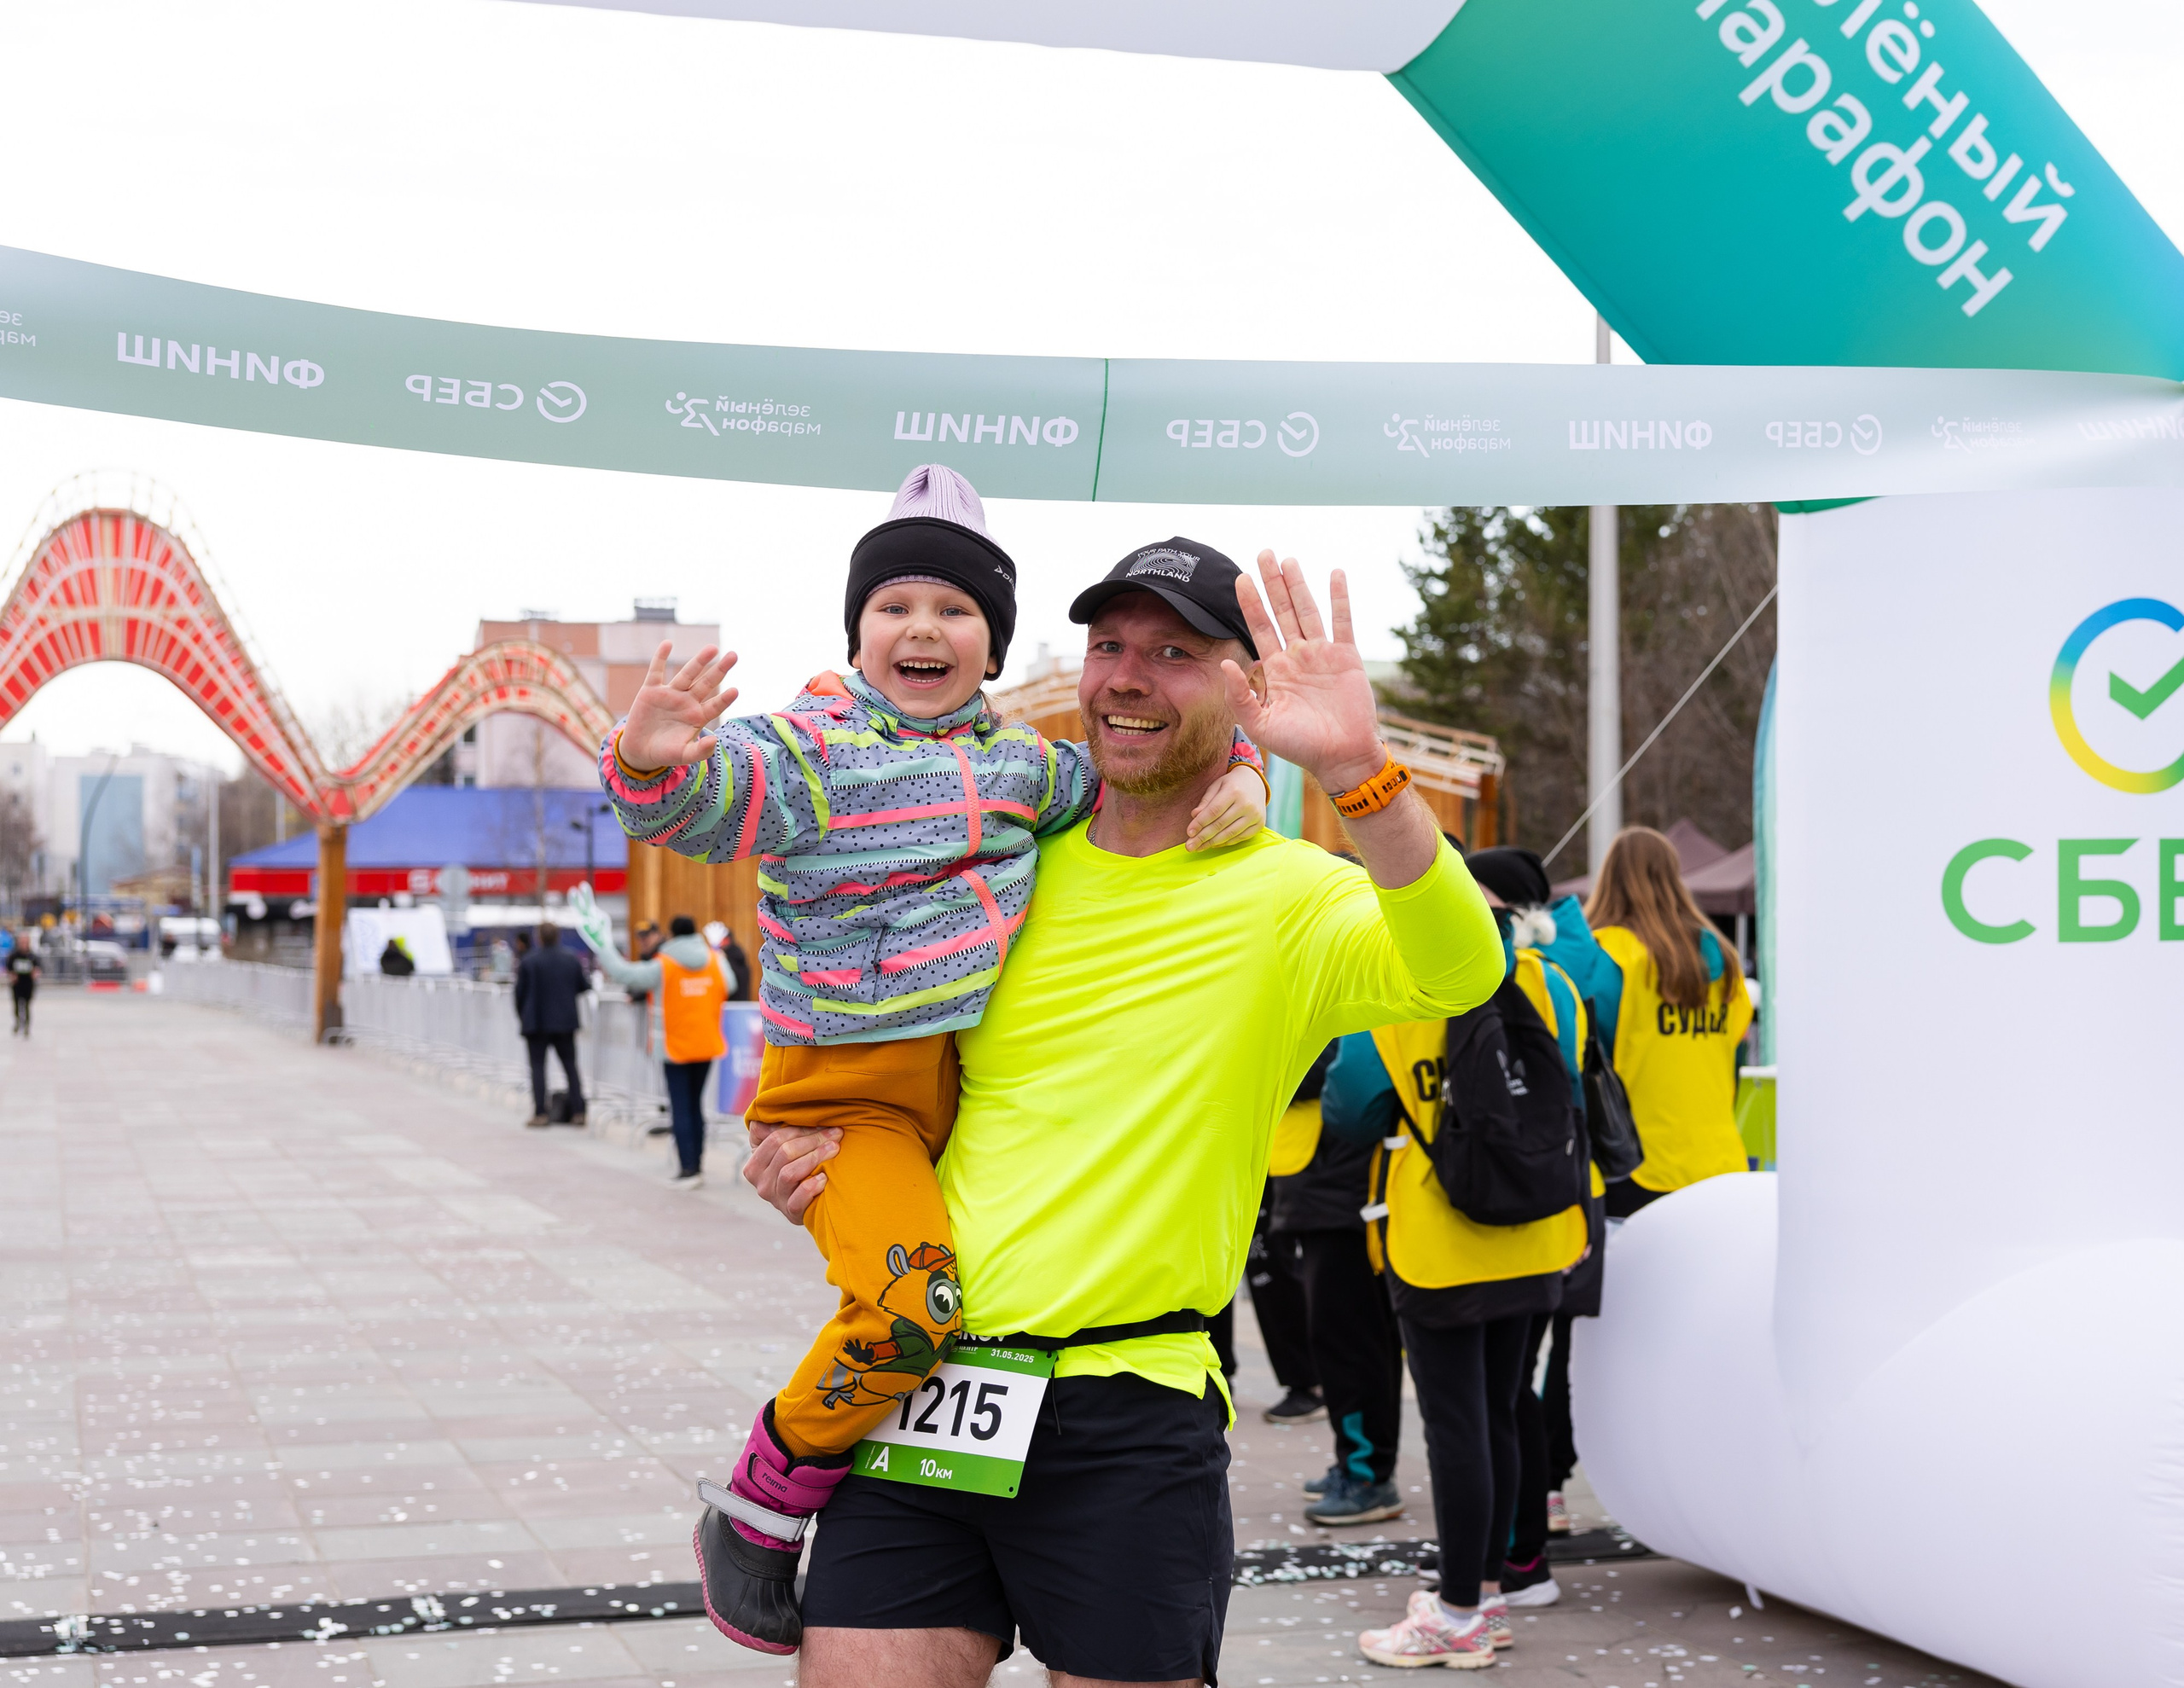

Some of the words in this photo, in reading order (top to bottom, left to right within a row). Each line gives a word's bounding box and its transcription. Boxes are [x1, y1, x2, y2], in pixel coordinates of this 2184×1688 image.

[1695, 0, 2013, 317] арафон
[1179, 550, 1201, 562] YOUR
[1125, 569, 1190, 583] NORTHLAND
[990, 1349, 1035, 1363] 31.05.2025
[898, 1376, 1009, 1441] 1215
[762, 1472, 788, 1493] reima
